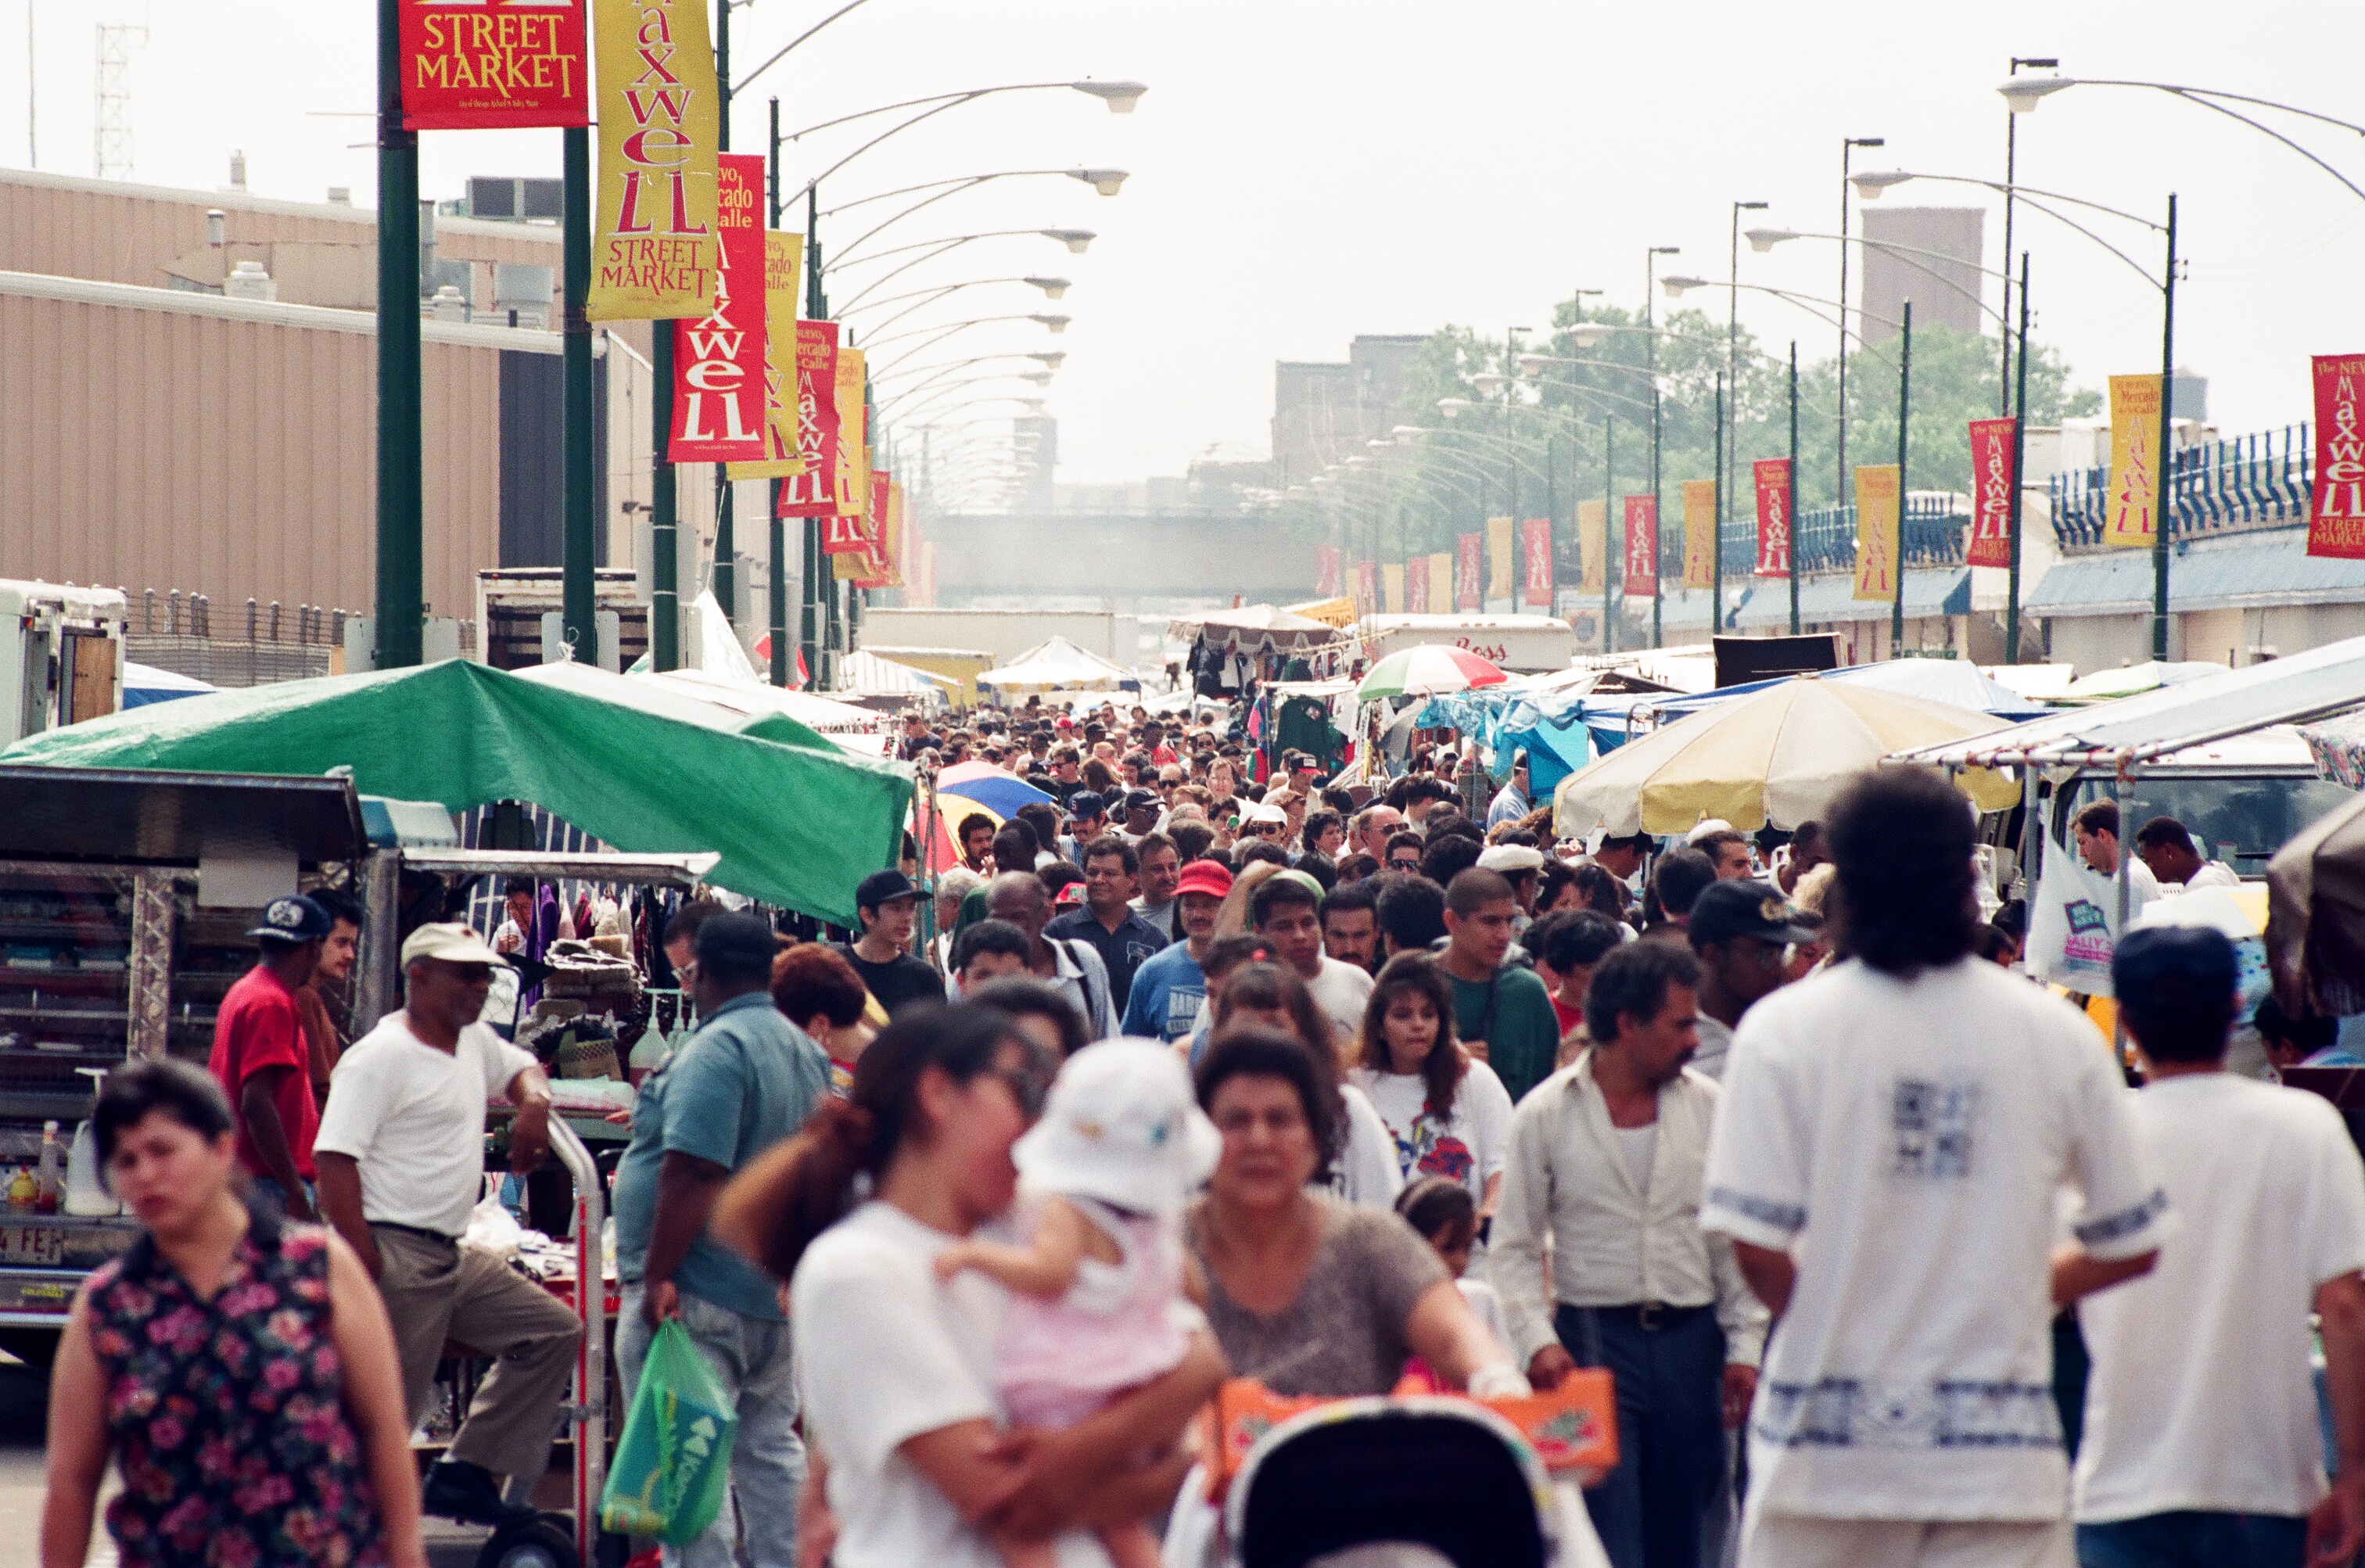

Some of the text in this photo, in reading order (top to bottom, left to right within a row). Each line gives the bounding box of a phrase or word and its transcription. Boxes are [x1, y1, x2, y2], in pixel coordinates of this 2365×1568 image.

[423, 13, 564, 59] STREET
[415, 45, 576, 98] MARKET
[607, 0, 711, 237] axweLL
[719, 167, 753, 209] cado
[719, 208, 753, 228] alle
[609, 239, 702, 270] STREET
[599, 260, 709, 299] MARKET
[766, 275, 789, 291] alle
[797, 335, 831, 357] ercado
[2312, 531, 2365, 547] MARKE
[2317, 518, 2365, 532] STREE
